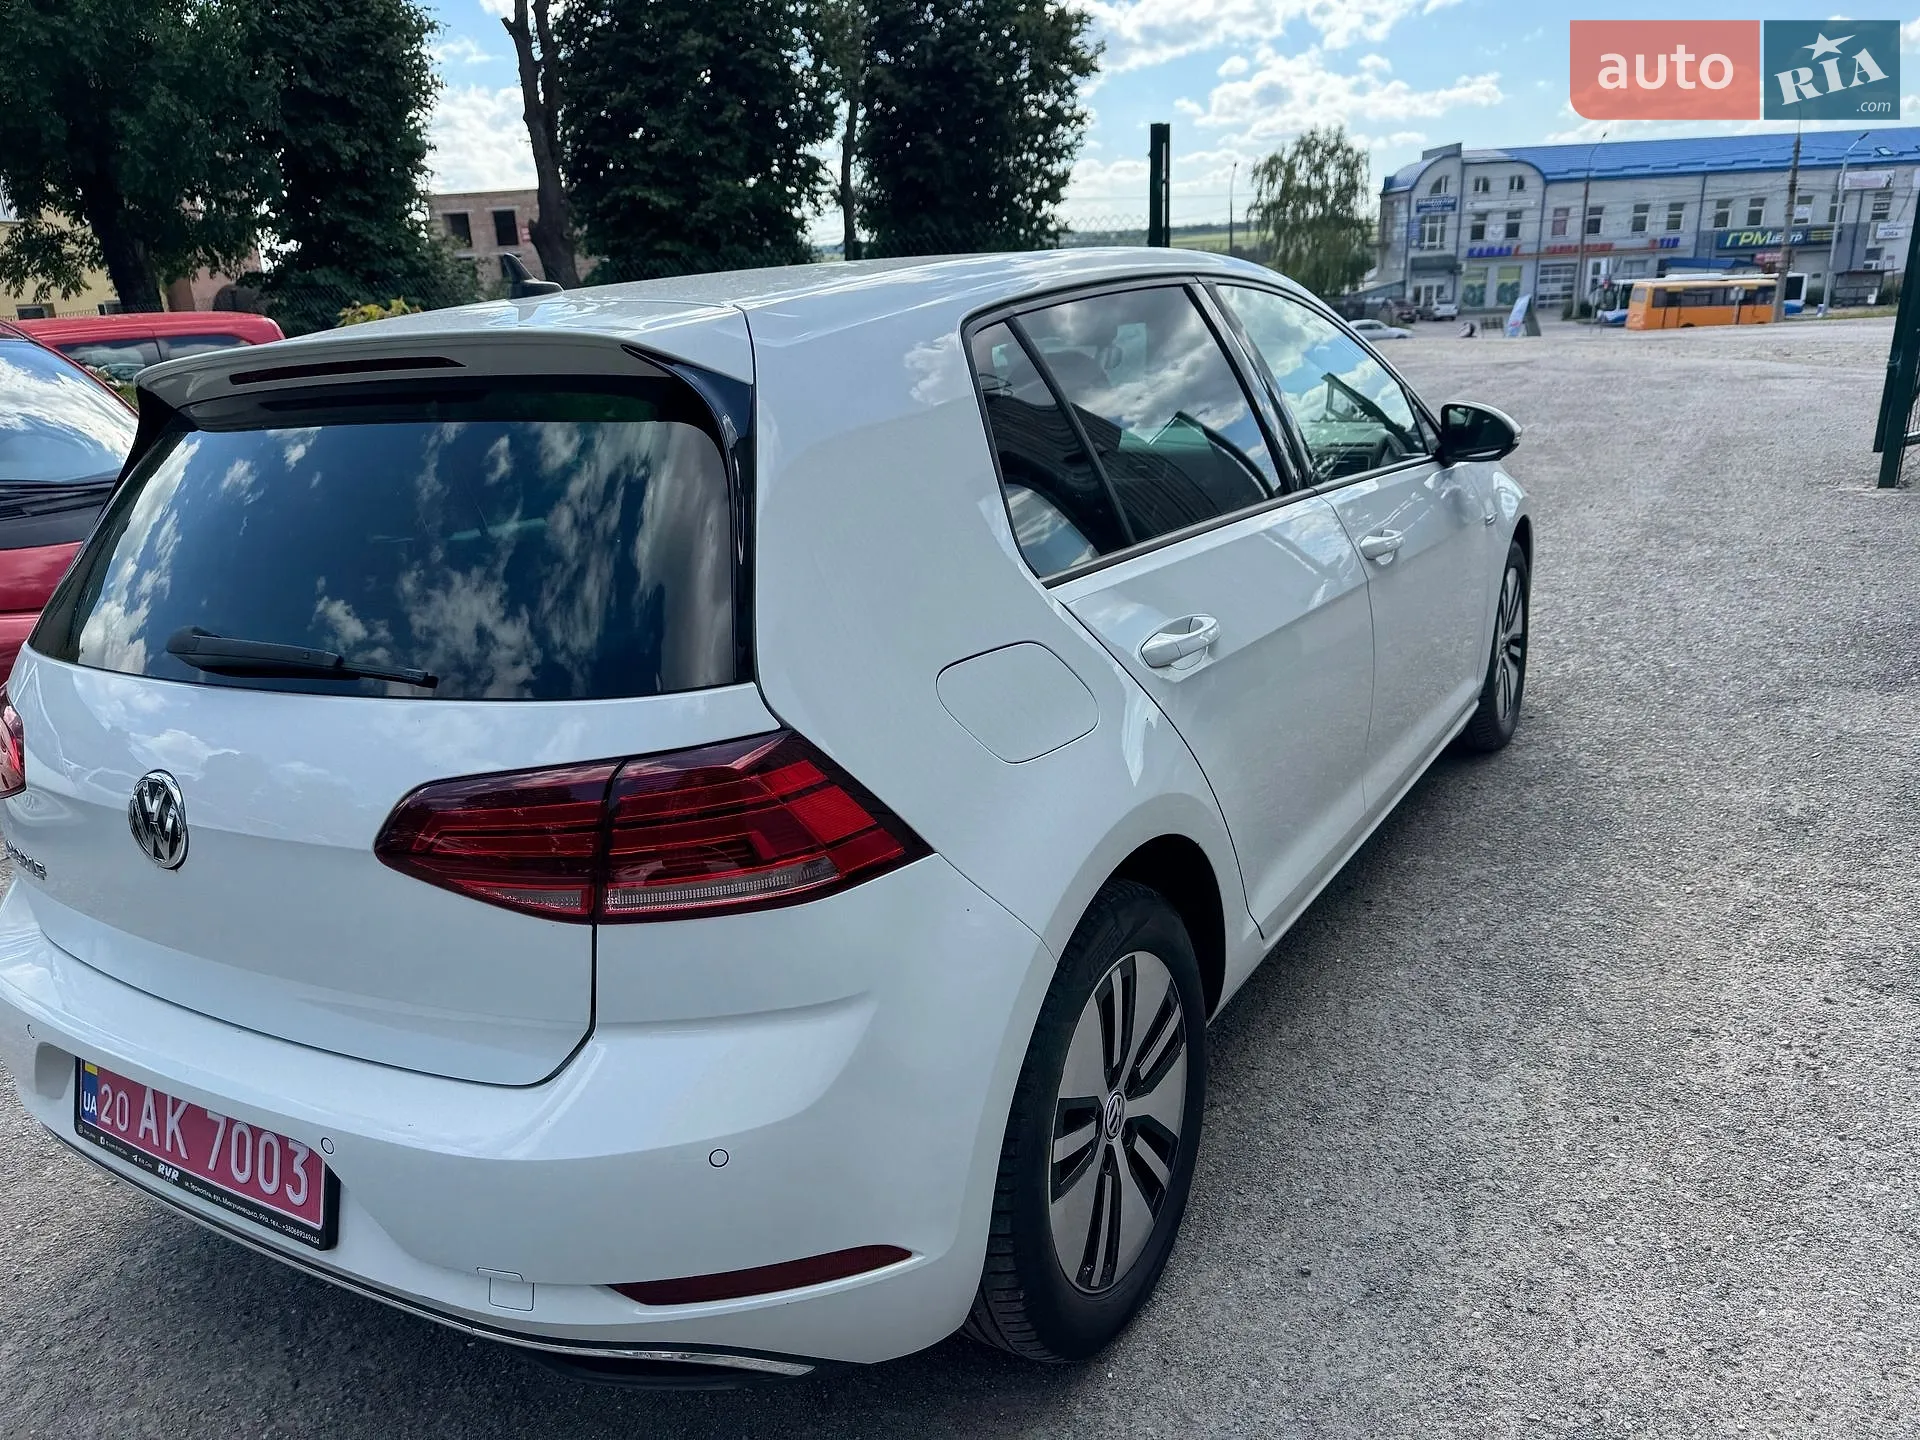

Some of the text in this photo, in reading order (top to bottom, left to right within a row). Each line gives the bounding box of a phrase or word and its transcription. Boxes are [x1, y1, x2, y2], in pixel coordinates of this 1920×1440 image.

[83, 1090, 97, 1115] UA
[100, 1083, 309, 1206] 20 AK 7003
[157, 1162, 180, 1181] RVR
